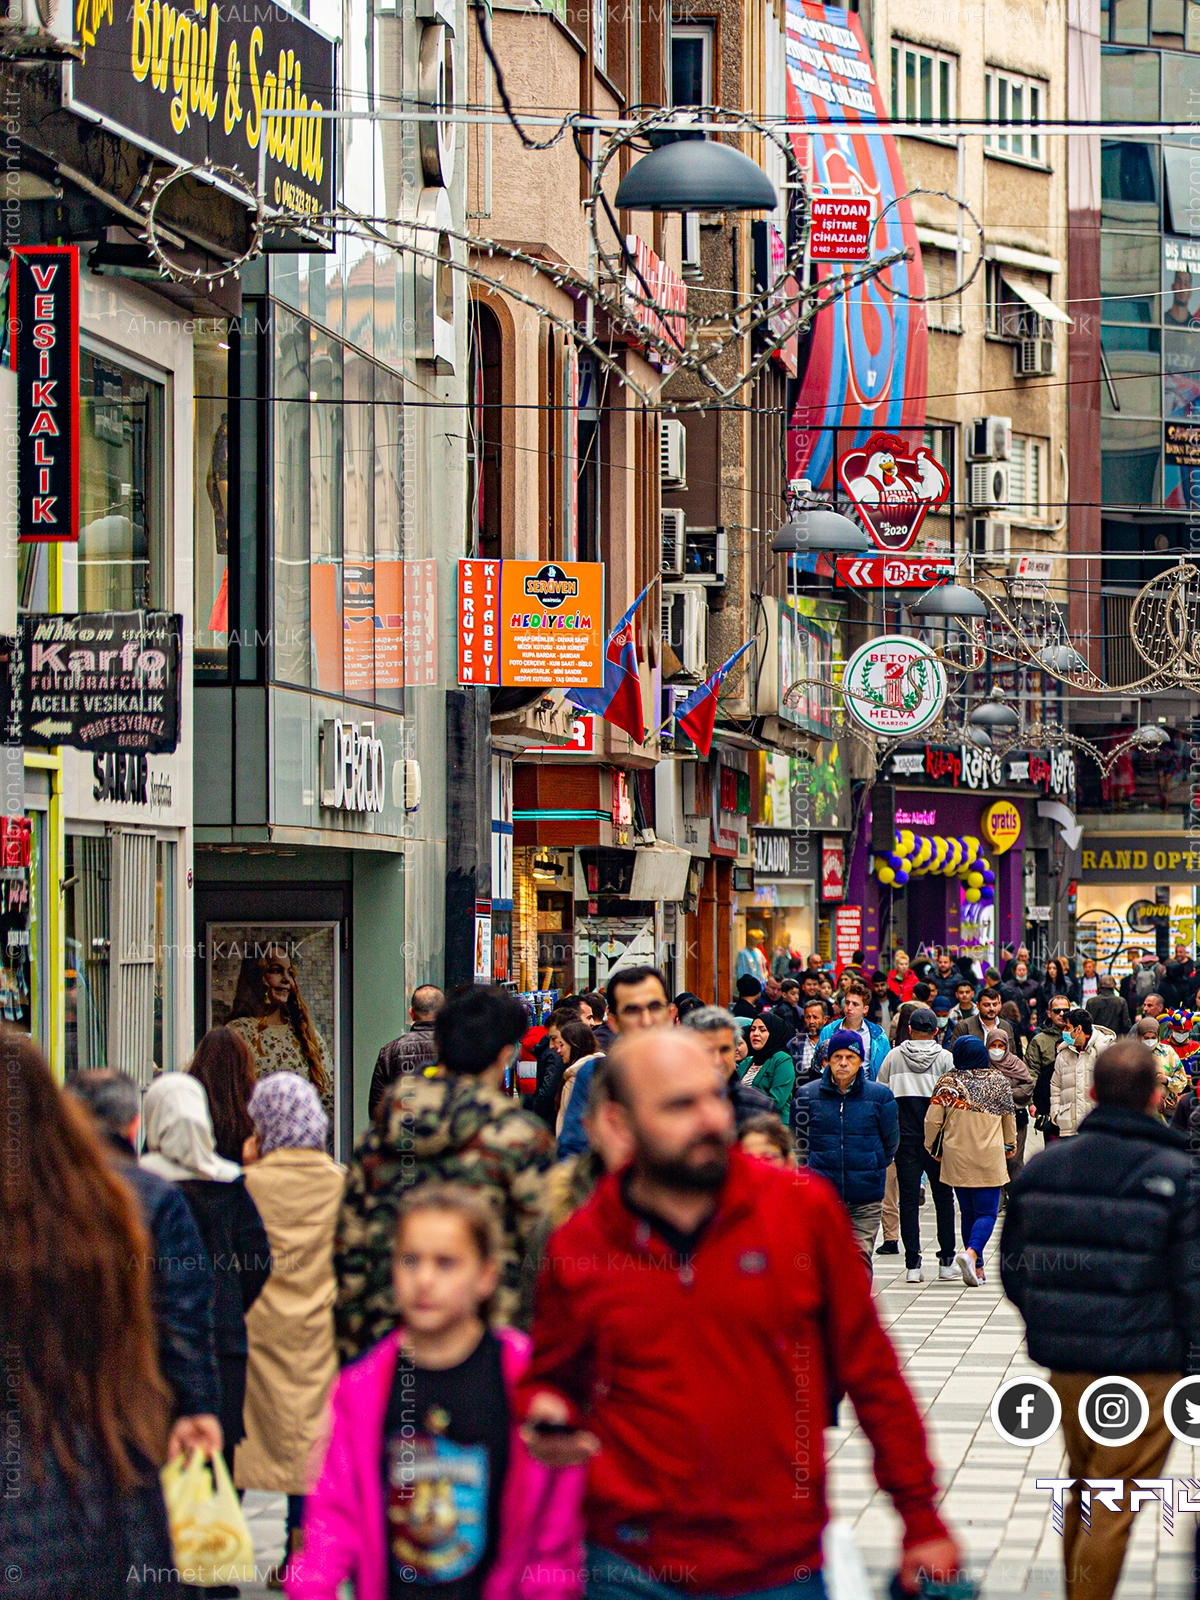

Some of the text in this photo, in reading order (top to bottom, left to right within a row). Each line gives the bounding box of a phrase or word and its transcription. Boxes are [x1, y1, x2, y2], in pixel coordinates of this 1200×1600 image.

[131, 0, 219, 135] Birgül
[224, 40, 242, 136] &
[246, 26, 323, 186] Saliha
[814, 204, 867, 216] MEYDAN
[822, 218, 858, 231] İŞİTME
[813, 231, 866, 243] CİHAZLARI
[1166, 242, 1179, 260] DİŞ
[29, 264, 59, 524] VESİKALIK
[884, 526, 908, 536] 2020
[526, 578, 576, 594] SERÜVEN
[462, 564, 474, 680] SERÜVEN
[483, 564, 494, 682] KİTABEVİ
[510, 610, 592, 629] HEDİYECİM
[33, 623, 114, 641] Nikon
[31, 643, 166, 672] Karfo
[870, 654, 918, 662] BETON
[514, 675, 532, 683] HEDİYE
[533, 675, 552, 683] KUTUSU
[31, 693, 164, 713] ACELE VESİKALIK
[870, 710, 916, 718] HELVA
[79, 715, 164, 743] PROFESYONEL
[926, 745, 962, 787] kitap
[961, 744, 1002, 790] kafe
[1050, 750, 1076, 794] kafe
[92, 752, 148, 805] SARAR
[992, 808, 1016, 836] gratis
[1082, 850, 1148, 870] RAND
[1139, 904, 1172, 917] BÜYÜK
